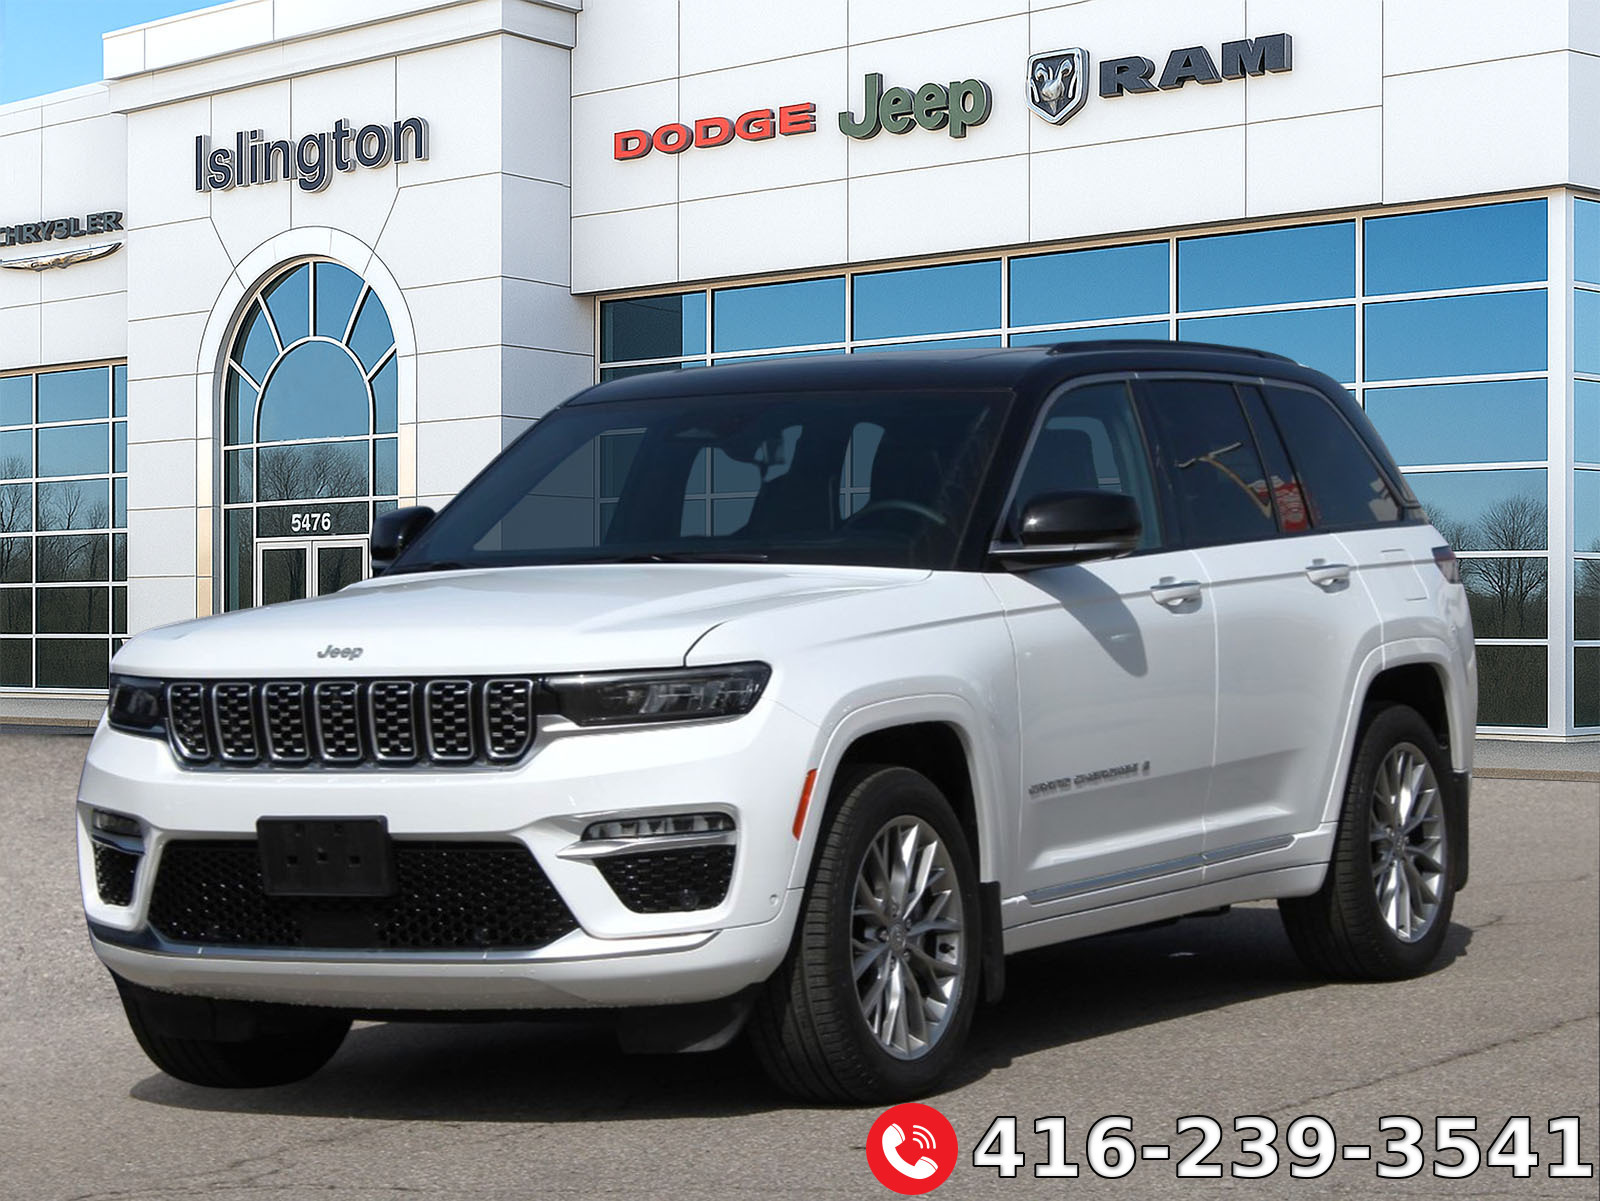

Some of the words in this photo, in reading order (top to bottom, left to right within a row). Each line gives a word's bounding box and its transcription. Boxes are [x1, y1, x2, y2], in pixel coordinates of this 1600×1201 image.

[1099, 33, 1293, 98] RAM
[614, 102, 817, 161] DODGE
[838, 73, 992, 140] Jeep
[195, 116, 430, 193] Islington
[291, 512, 331, 532] 5476
[317, 644, 364, 661] Jeep
